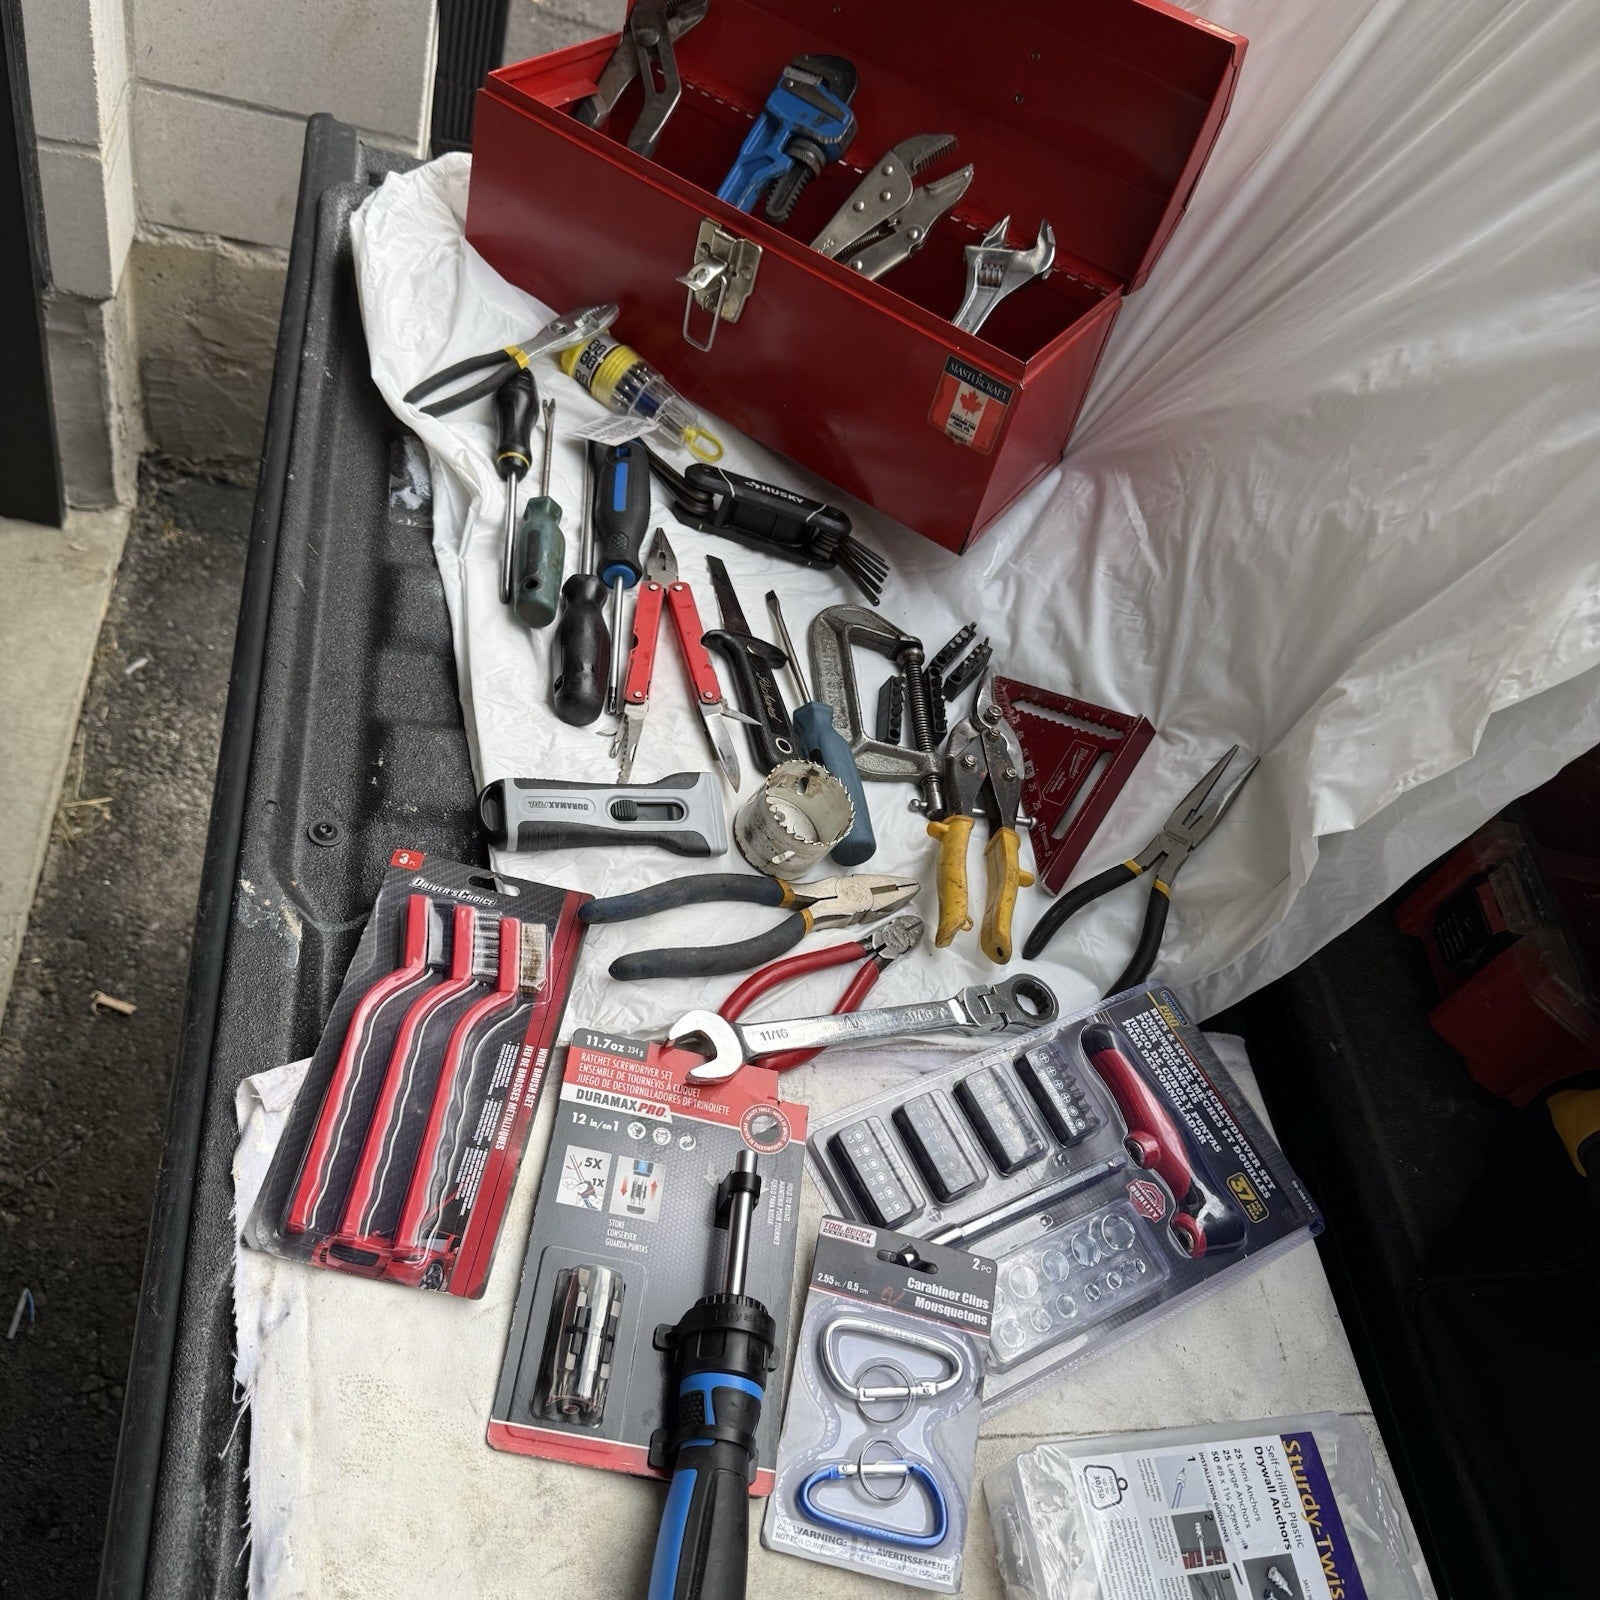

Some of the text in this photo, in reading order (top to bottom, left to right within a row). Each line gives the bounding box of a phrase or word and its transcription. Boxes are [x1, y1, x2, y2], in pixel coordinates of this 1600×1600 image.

[949, 362, 1007, 399] MASTERCRAFT
[760, 484, 804, 504] HUSKY
[1026, 781, 1037, 792] 35
[1031, 800, 1042, 811] 25
[1036, 822, 1046, 832] 15
[398, 852, 409, 865] 3
[584, 1034, 626, 1053] 11.7oz
[759, 1027, 788, 1041] 11/16
[518, 1057, 529, 1068] DE
[521, 1043, 534, 1057] JEU
[1134, 1012, 1200, 1105] POUR TOURNEVIS
[522, 1047, 548, 1108] WIRE BRUSH SET
[580, 1052, 673, 1080] RATCHET SCREWDRIVER SET
[508, 1066, 527, 1102] BROSSES
[578, 1063, 615, 1079] ENSEMBLE
[615, 1070, 627, 1081] DE
[627, 1073, 665, 1090] TOURNEVIS
[672, 1083, 700, 1097] CLIQUET
[1120, 1019, 1144, 1049] PARA
[1139, 1048, 1208, 1146] DESTORNILLADOR
[1126, 1016, 1153, 1050] JUEGO
[1149, 1049, 1165, 1068] DE
[1160, 1066, 1188, 1103] CUBOS
[1190, 1110, 1222, 1154] PUNTAS
[576, 1073, 730, 1115] JUEGO DE DESTORNILLADORES DE TRINQUETE
[1140, 1009, 1182, 1067] ENSEMBLE
[1178, 1065, 1194, 1083] DE
[1220, 1127, 1235, 1145] ET
[1231, 1143, 1271, 1200] DOUILLES
[1149, 1006, 1276, 1192] BITS & SOCKETS SCREWDRIVER SET
[571, 1111, 587, 1125] 12
[584, 1156, 602, 1169] 5X
[591, 1177, 604, 1187] 1X
[1229, 1174, 1256, 1206] 37
[1128, 1184, 1158, 1218] QUALITY
[606, 1227, 637, 1241] CONSERVER
[971, 1257, 992, 1273] 2 PC
[816, 1272, 835, 1285] 2.55
[906, 1276, 990, 1309] Carabiner Clips
[914, 1296, 988, 1325] Mousquetons
[1186, 1455, 1196, 1463] 1
[1210, 1449, 1220, 1463] 50
[1214, 1463, 1225, 1477] #8
[1093, 1474, 1105, 1499] 30/50
[1197, 1451, 1230, 1543] INSTALLATION GUIDELINES
[1221, 1448, 1253, 1529] 25 Large Anchors
[1233, 1446, 1262, 1522] 25 Mini Anchors
[1265, 1443, 1306, 1549] Self-drilling Plastic
[1251, 1444, 1294, 1551] Drywall Anchors
[1203, 1512, 1214, 1522] 2
[1226, 1502, 1243, 1536] Screws
[1220, 1570, 1230, 1581] 3
